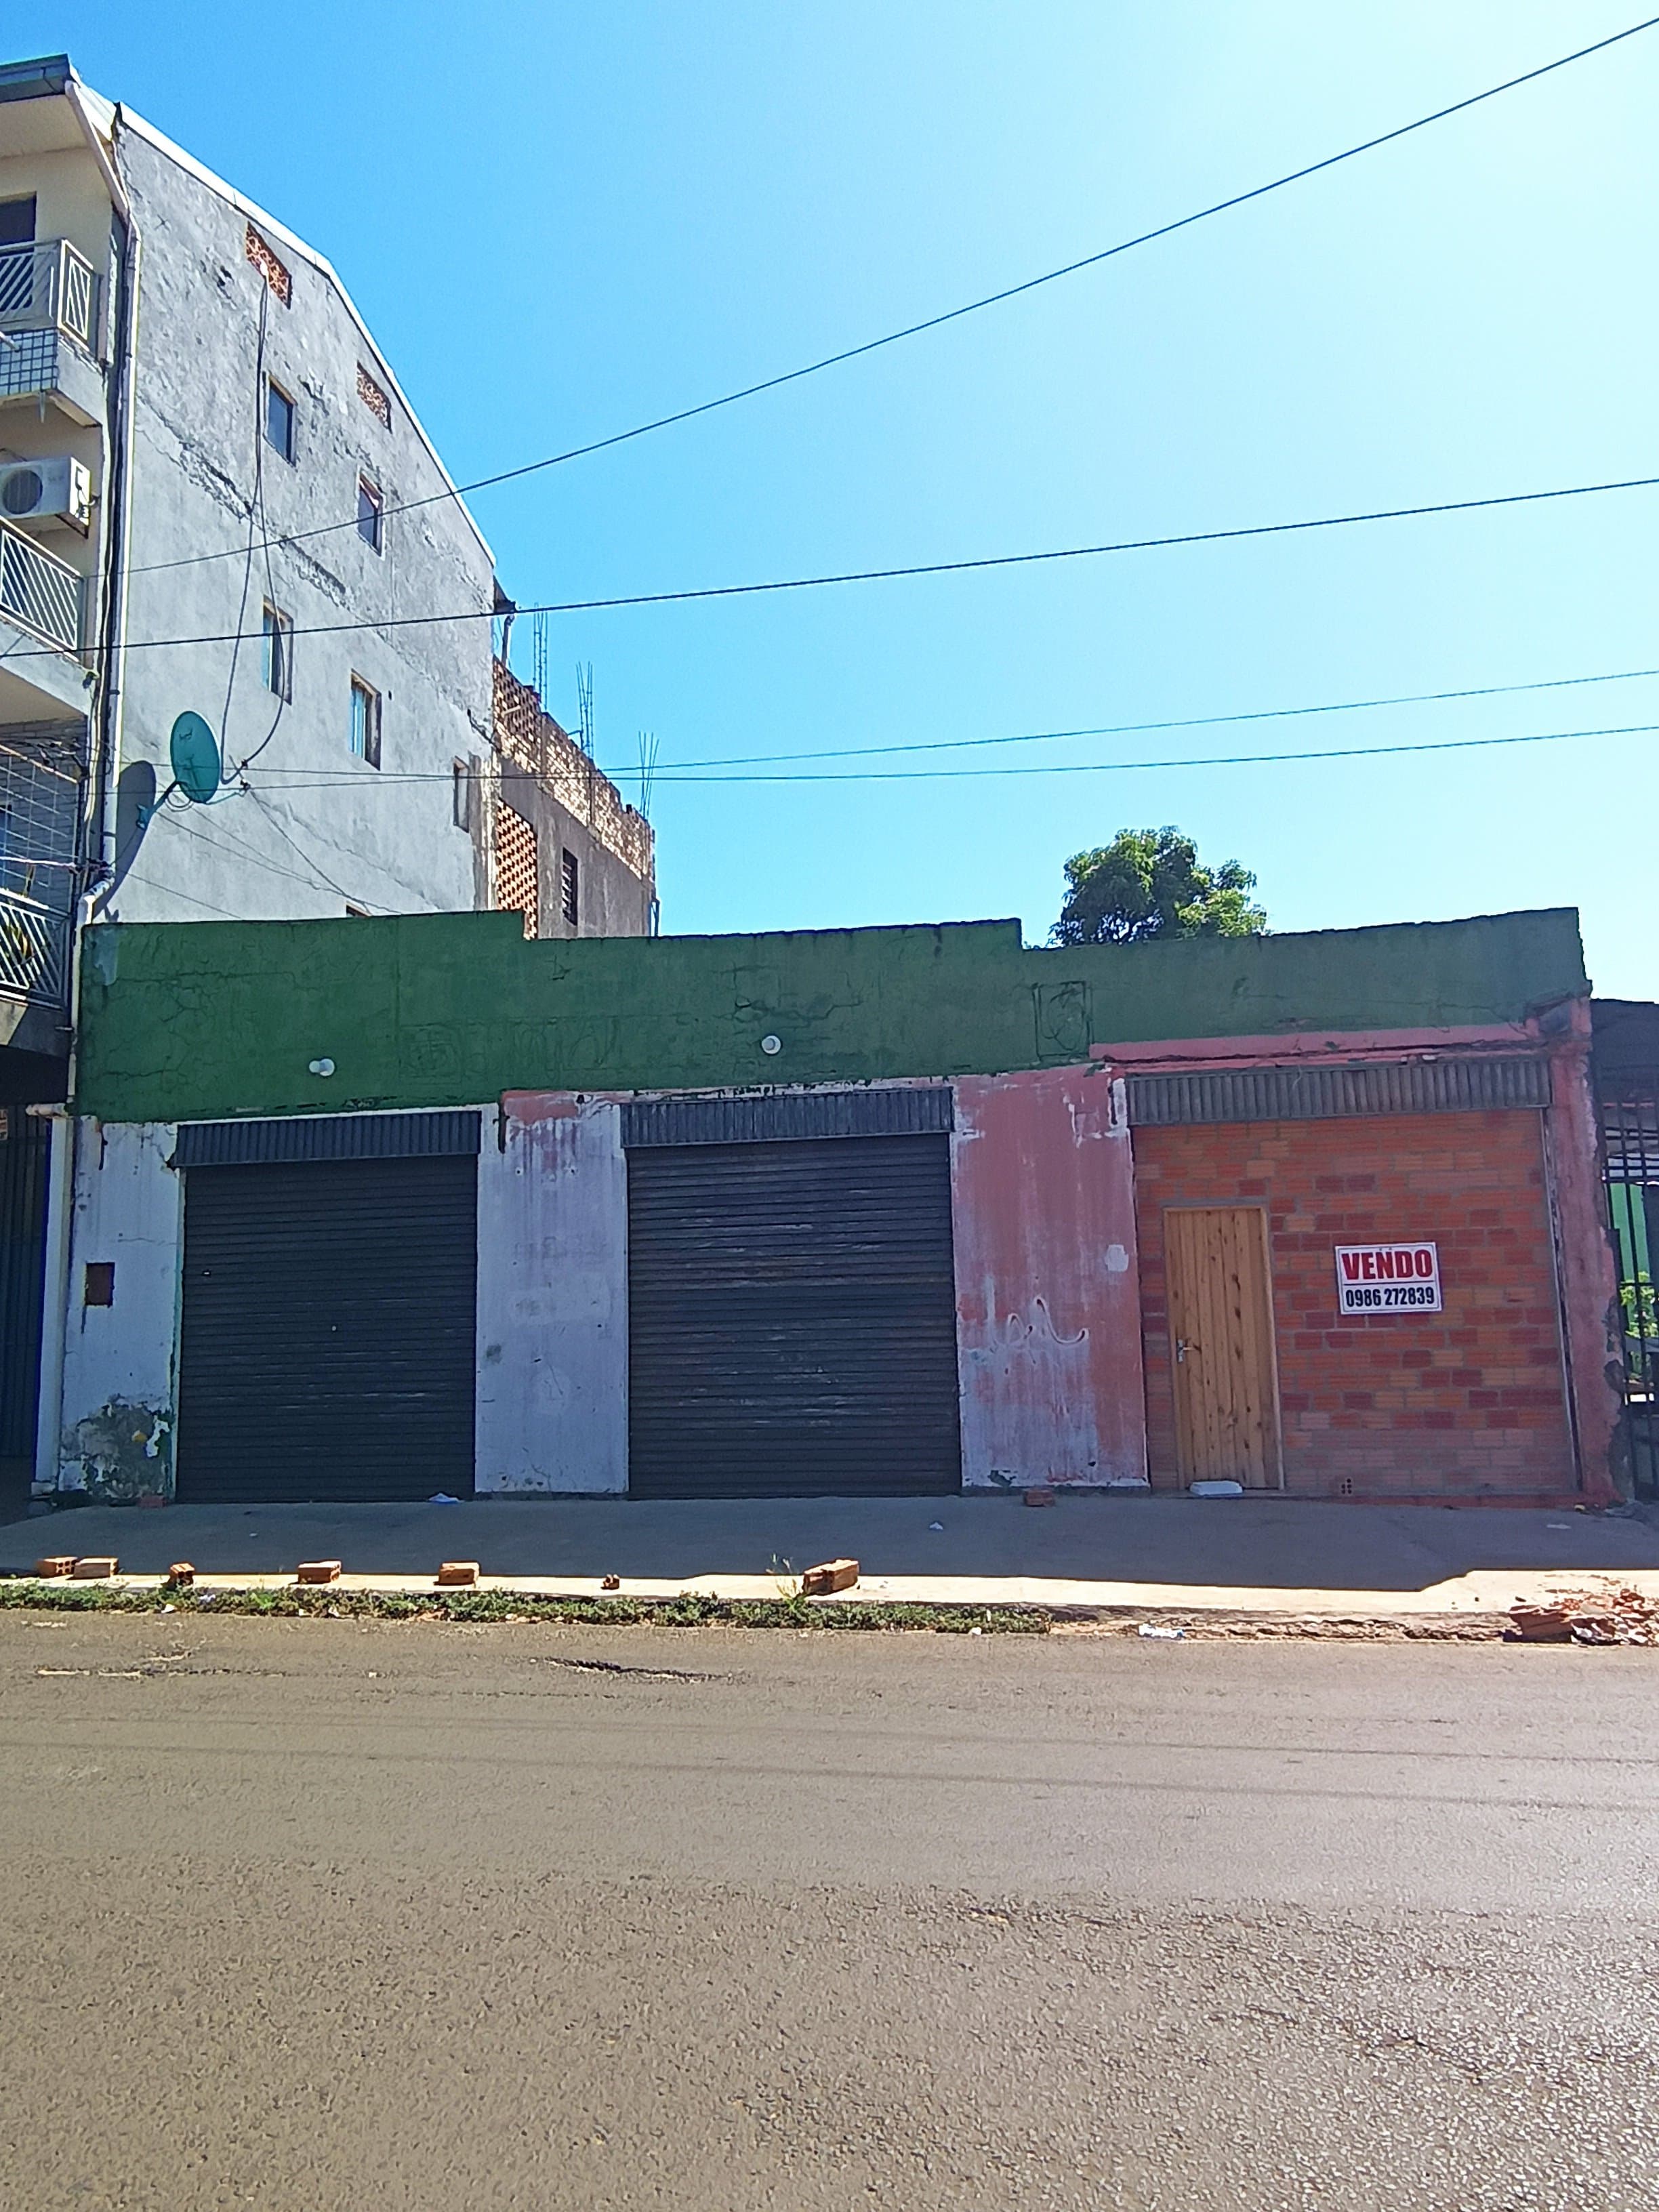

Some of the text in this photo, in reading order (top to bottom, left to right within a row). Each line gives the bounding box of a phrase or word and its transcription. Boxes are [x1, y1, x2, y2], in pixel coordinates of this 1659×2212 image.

[1341, 1250, 1433, 1280] VENDO
[1345, 1286, 1435, 1307] 0986 272839
